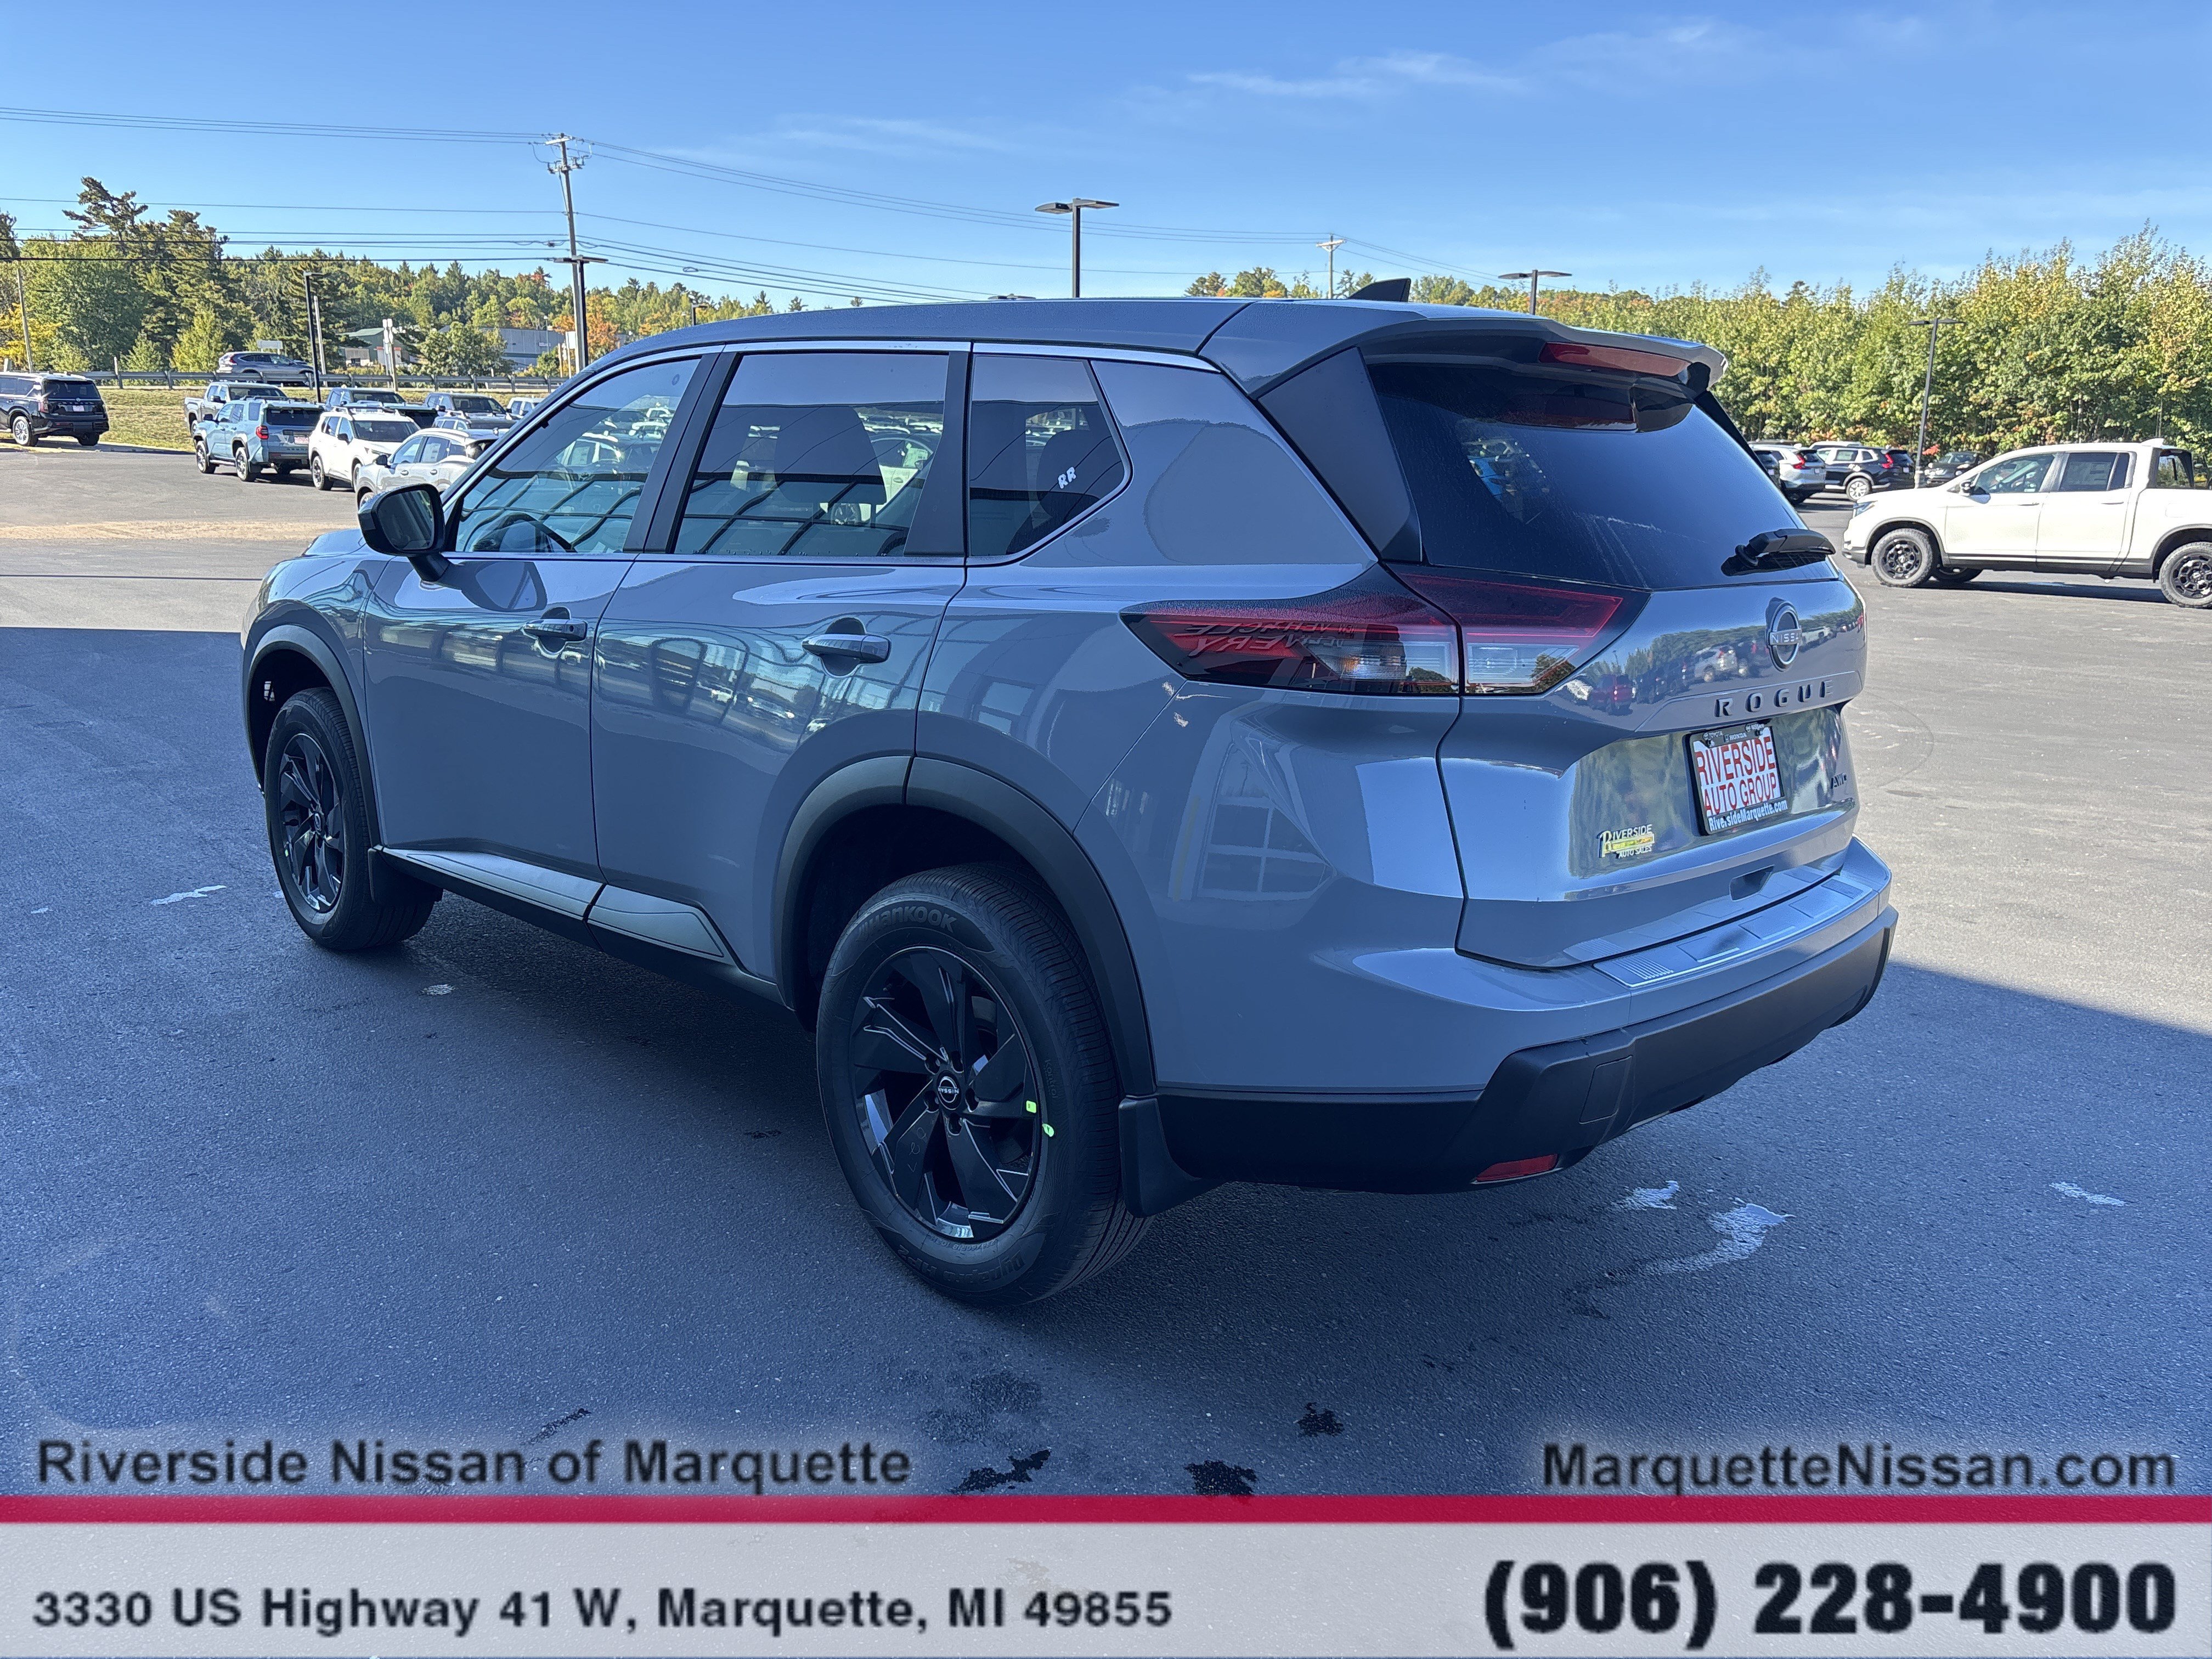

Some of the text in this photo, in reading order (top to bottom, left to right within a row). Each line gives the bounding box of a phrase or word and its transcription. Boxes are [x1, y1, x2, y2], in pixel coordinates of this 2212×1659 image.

[1058, 466, 1076, 488] RR
[1714, 680, 1833, 718] ROGUE
[1729, 732, 1747, 741] HONDA
[1694, 736, 1775, 786] RIVERSIDE
[1705, 772, 1776, 816] AUTO GROUP
[1708, 800, 1788, 832] RiversideMarquette.com
[1599, 823, 1653, 857] RIVERSIDE
[1617, 844, 1652, 859] AUTO SALES
